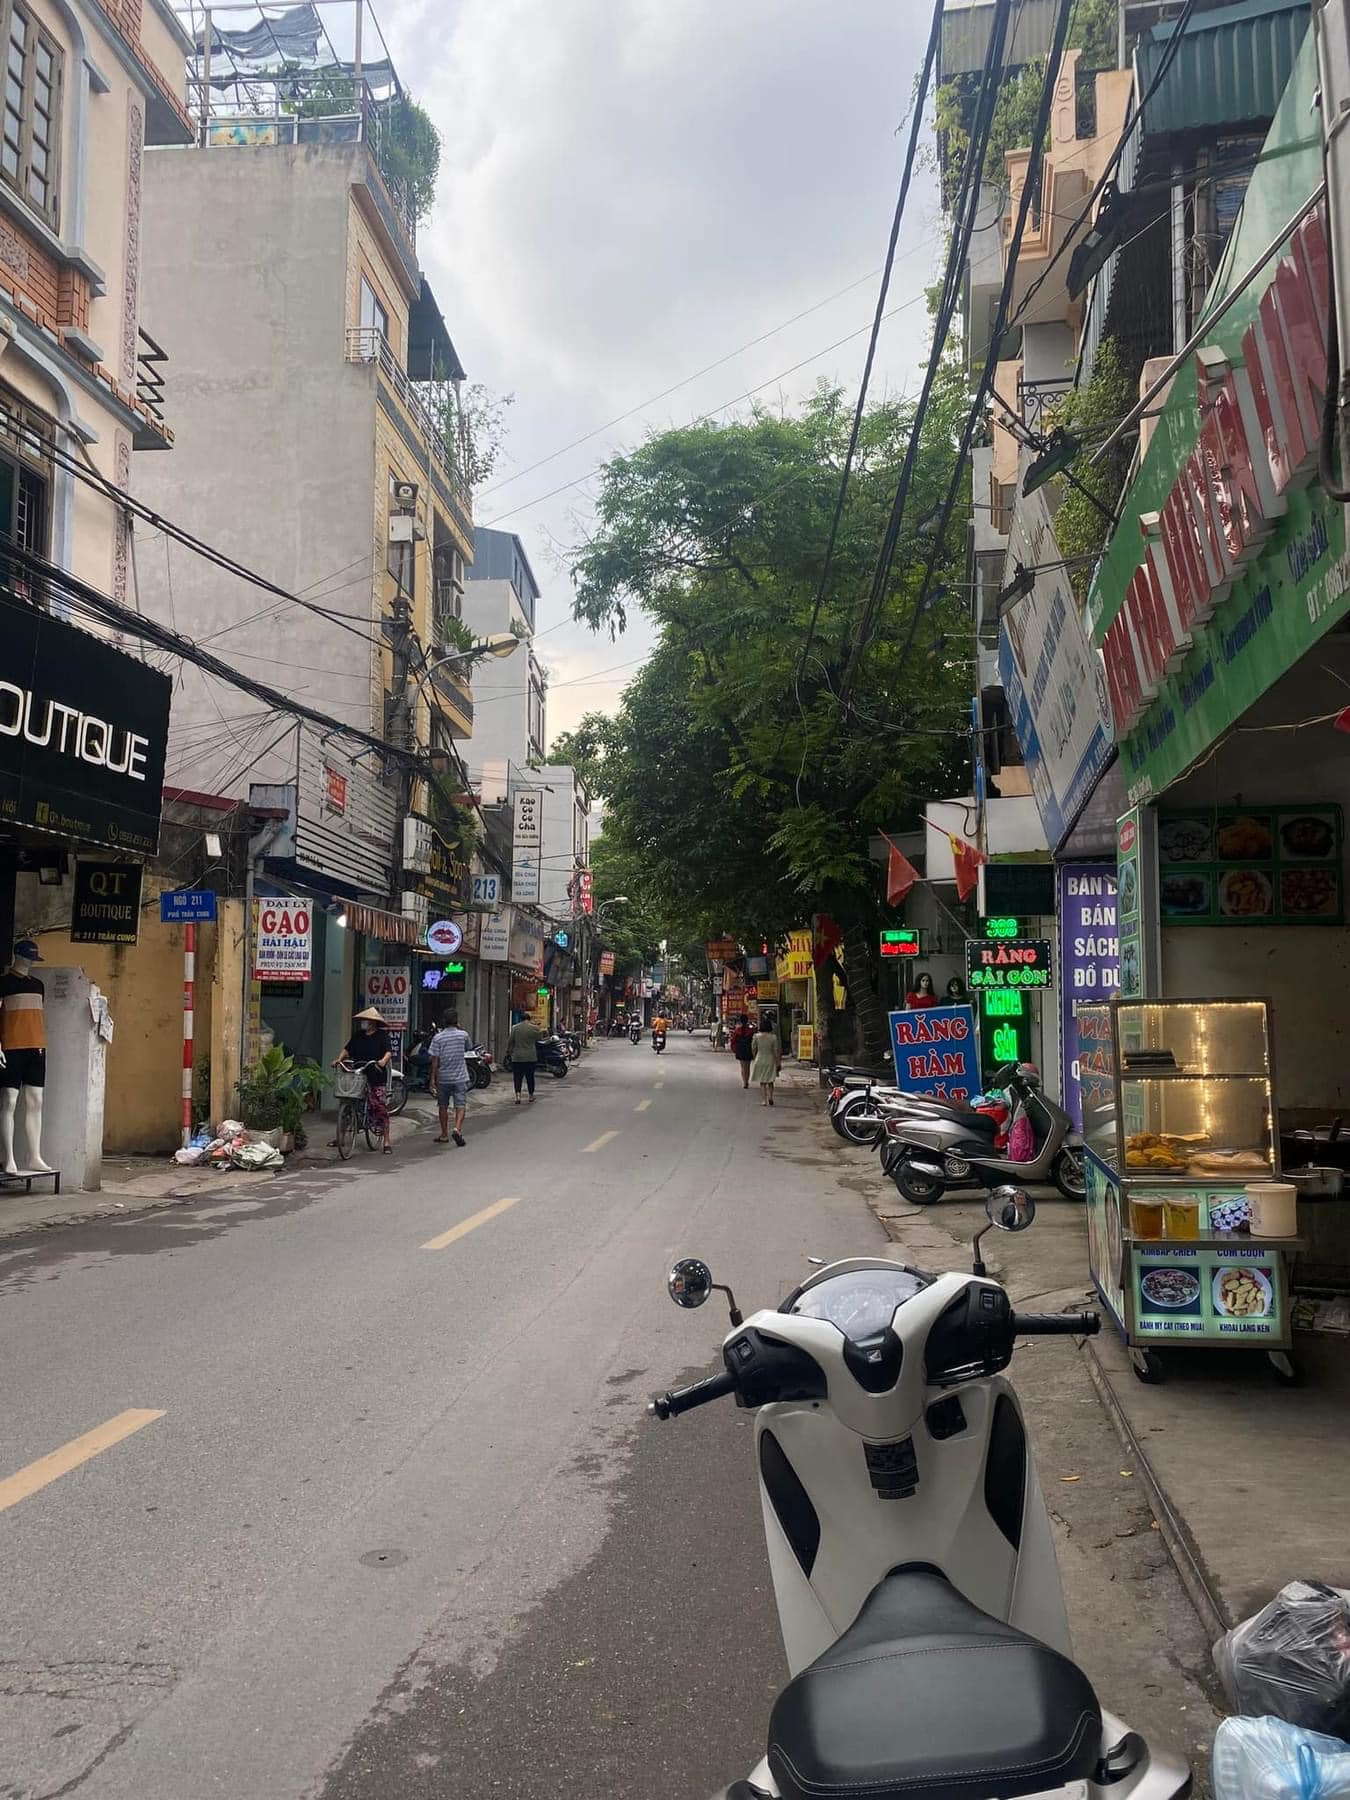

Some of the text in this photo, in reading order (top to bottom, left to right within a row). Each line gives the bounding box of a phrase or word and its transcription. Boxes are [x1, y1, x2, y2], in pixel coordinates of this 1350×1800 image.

[0, 680, 149, 781] OUTIQUE
[90, 872, 127, 896] QT
[473, 879, 496, 900] 213
[1067, 873, 1103, 896] BÁN
[80, 904, 132, 920] BOUTIQUE
[192, 896, 202, 906] 211
[262, 910, 309, 938] GẠO
[1081, 903, 1116, 927] BÁN
[981, 944, 1038, 964] RĂNG
[1074, 934, 1120, 957] SÁCH
[971, 965, 1048, 985] SÀI GÒN
[1073, 962, 1120, 988] ĐỒ DÙ
[368, 976, 406, 998] GẠO
[896, 1014, 970, 1046] RĂNG
[908, 1049, 966, 1079] HÀM
[1240, 1324, 1256, 1333] LANG
